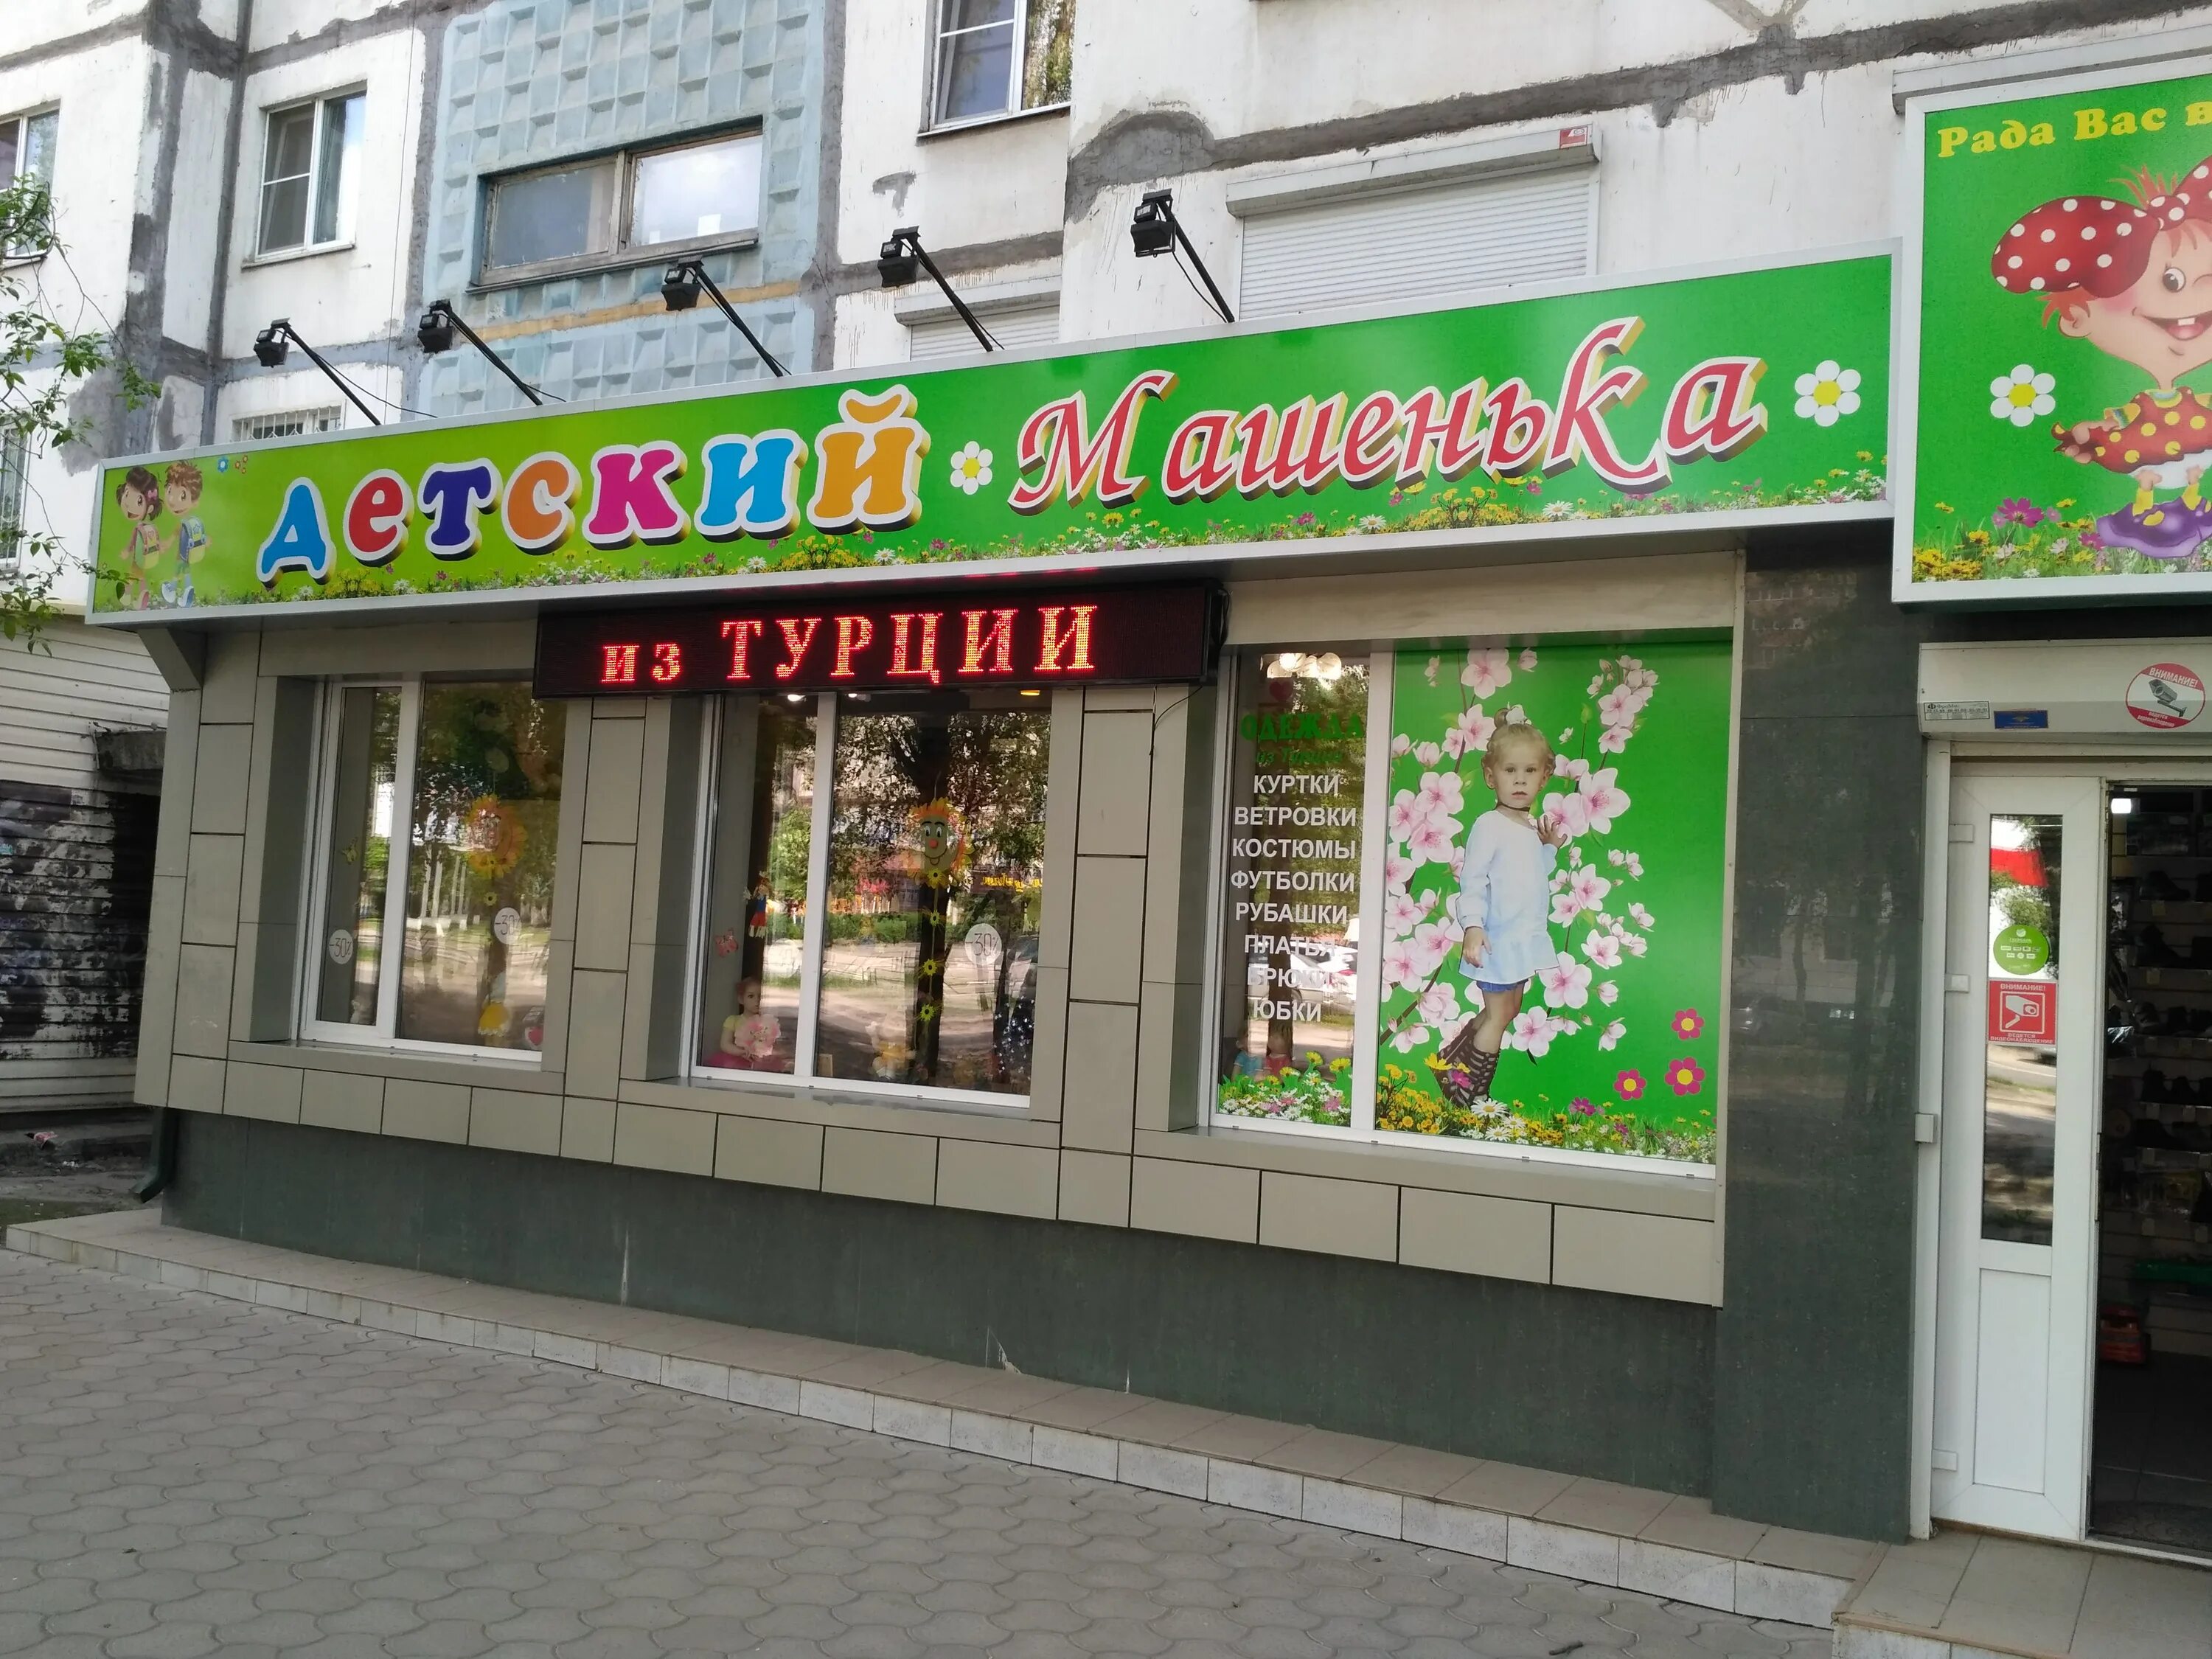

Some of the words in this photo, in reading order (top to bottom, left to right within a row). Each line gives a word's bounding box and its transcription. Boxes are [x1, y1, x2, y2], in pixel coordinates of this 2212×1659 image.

[1936, 119, 2056, 158] Рада
[2073, 108, 2168, 141] Вас
[256, 384, 931, 588] Детский
[1007, 316, 1768, 516] Машенька
[600, 643, 683, 684] из
[720, 605, 1099, 684] ТУРЦИИ
[2149, 667, 2198, 688] ВНИМАНИЕ!
[1240, 712, 1364, 742] ОДЕЖДА
[1253, 775, 1339, 794] КУРТКИ
[1234, 807, 1356, 827] ВЕТРОВКИ
[1232, 838, 1356, 859] КОСТЮМЫ
[1231, 870, 1354, 892] ФУТБОЛКИ
[1236, 902, 1348, 924] РУБАШКИ
[1245, 934, 1336, 957] ПЛАТЬЯ
[2000, 983, 2046, 991] ВНИМАНИЕ!
[1253, 999, 1322, 1023] ЮБКИ
